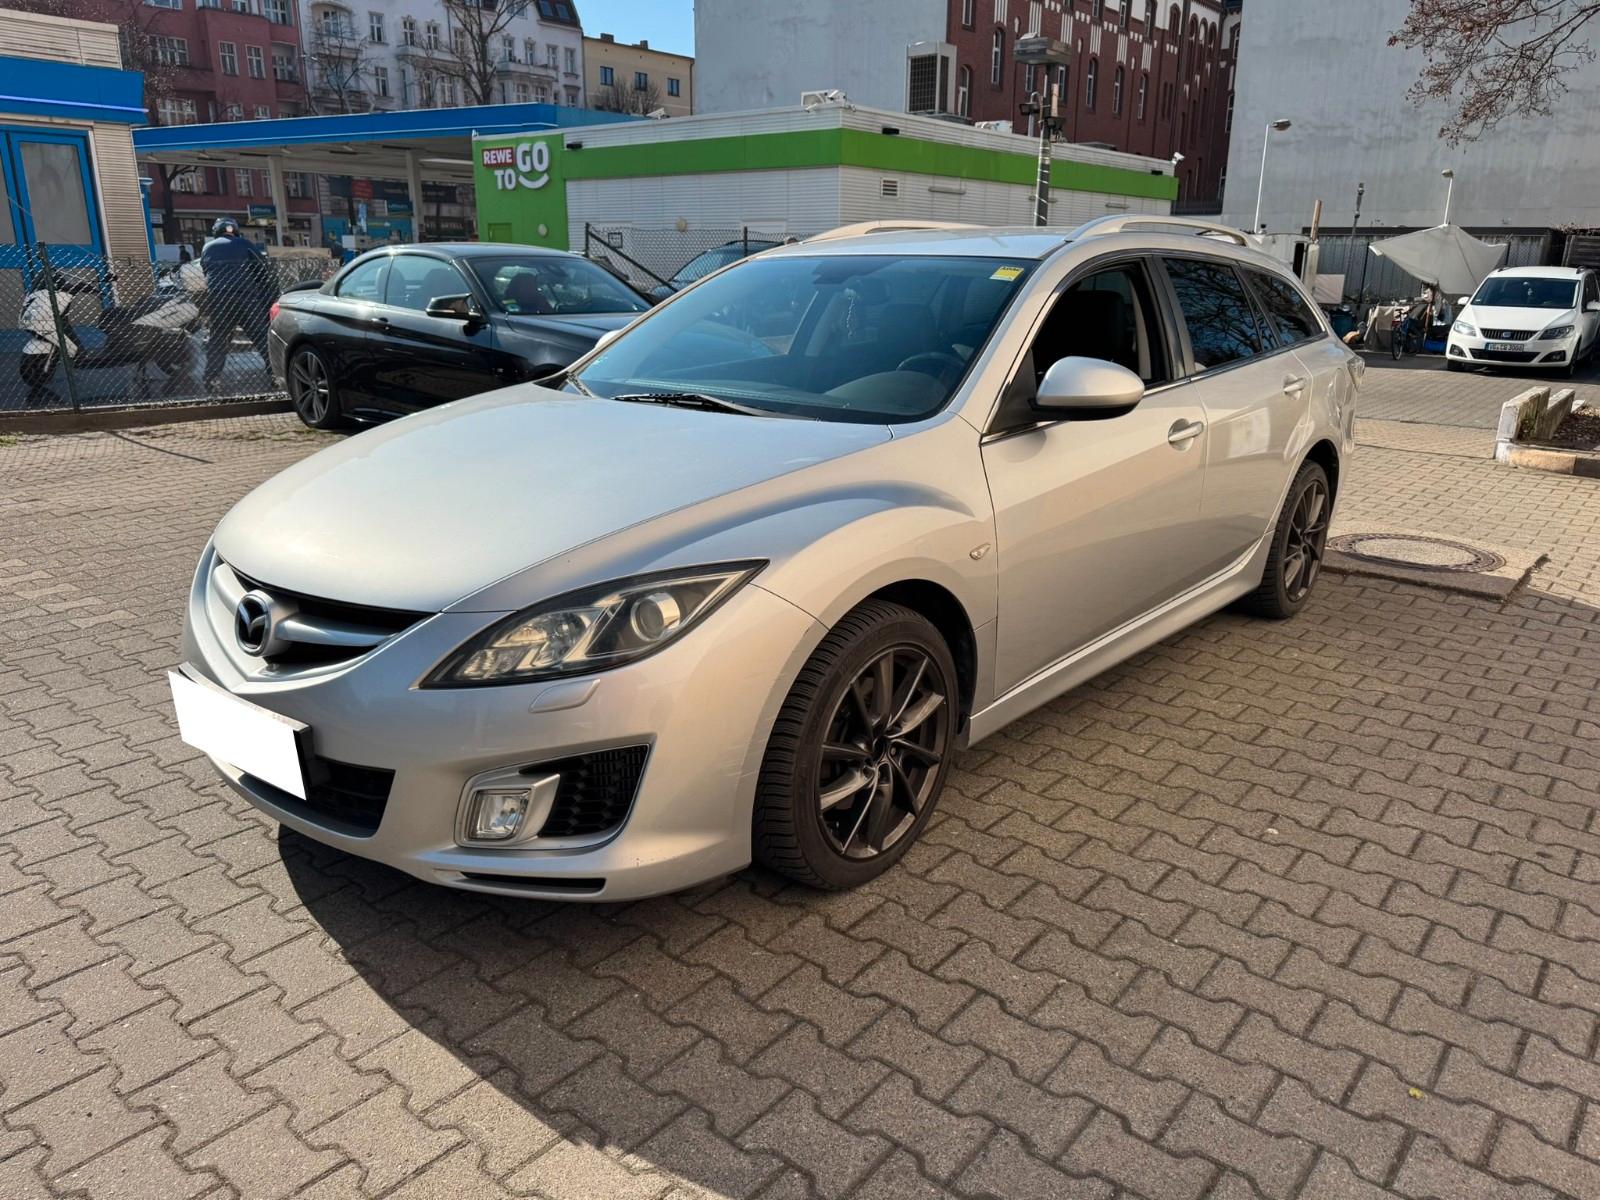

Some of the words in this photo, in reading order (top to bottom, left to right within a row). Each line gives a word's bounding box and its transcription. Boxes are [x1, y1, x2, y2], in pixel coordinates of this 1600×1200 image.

[483, 149, 512, 165] REWE
[516, 141, 549, 173] GO
[494, 168, 516, 190] TO
